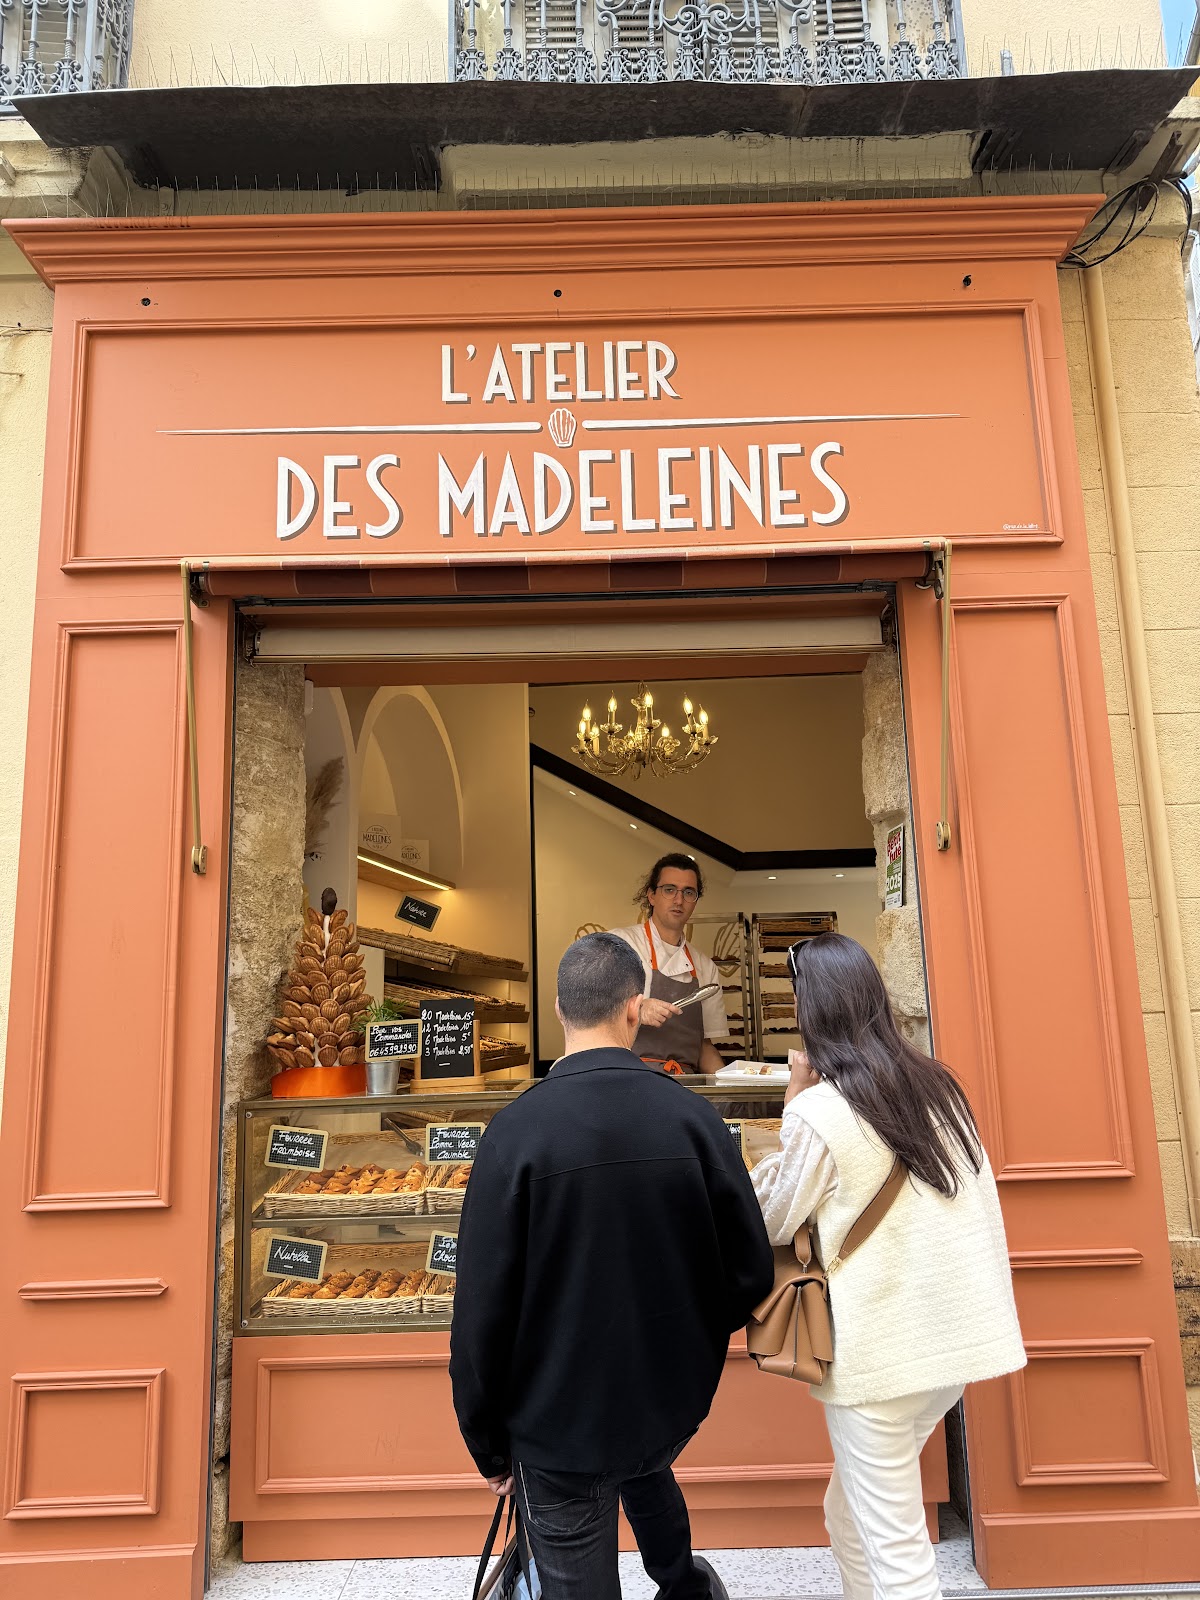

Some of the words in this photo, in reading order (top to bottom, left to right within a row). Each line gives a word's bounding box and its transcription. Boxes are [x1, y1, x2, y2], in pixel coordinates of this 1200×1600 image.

[440, 340, 681, 403] L'ATELIER
[276, 453, 403, 539] DES
[437, 441, 849, 535] MADELEINES
[421, 1008, 433, 1021] 20
[421, 1023, 432, 1033] 12
[424, 1034, 431, 1045] 6
[424, 1047, 431, 1057] 3
[273, 1244, 312, 1263] Nutella
[433, 1250, 457, 1262] Choco
